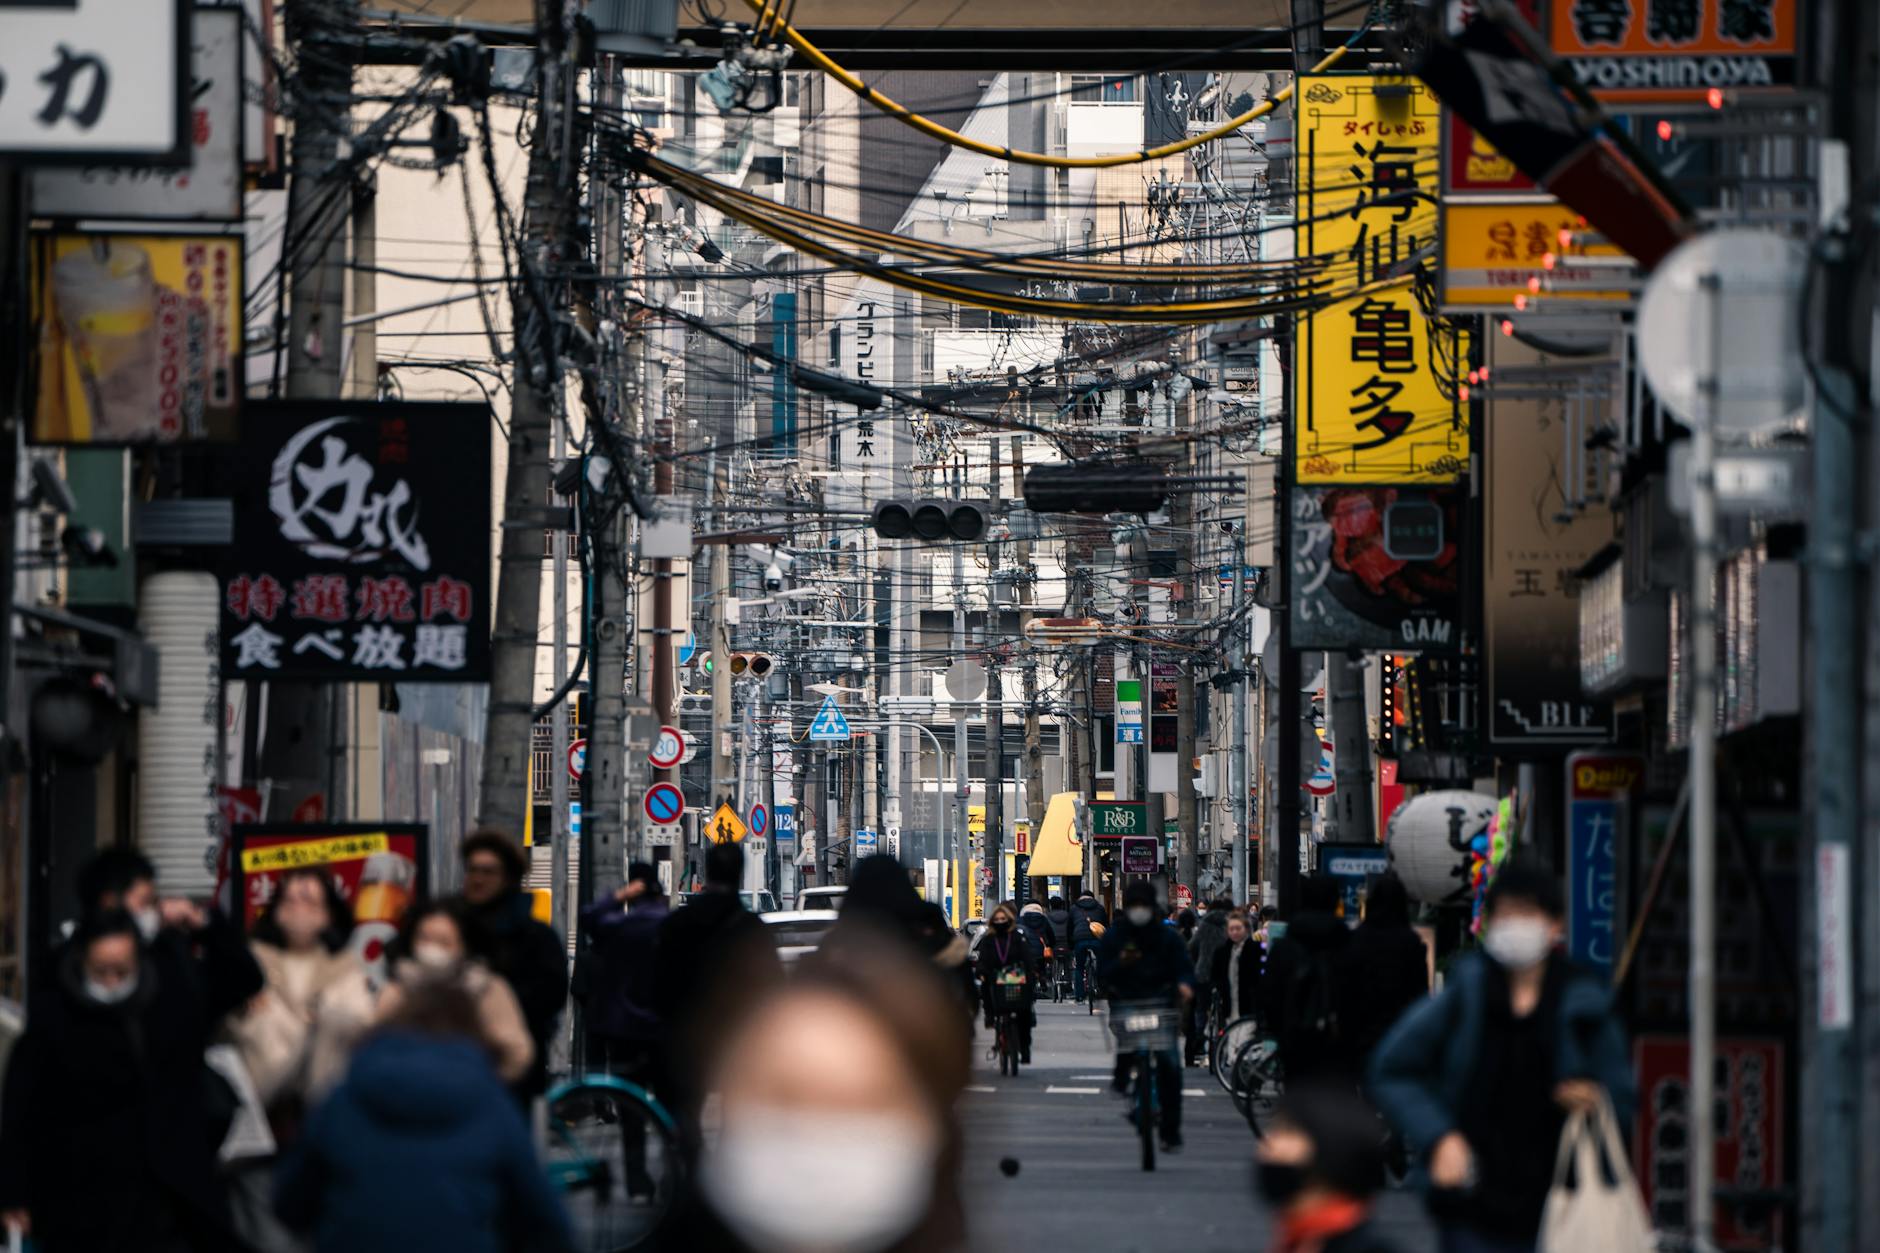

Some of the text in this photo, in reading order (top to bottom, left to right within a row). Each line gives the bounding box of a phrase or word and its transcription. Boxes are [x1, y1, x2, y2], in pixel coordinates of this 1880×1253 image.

[857, 302, 875, 457] グランビ荒木
[227, 574, 471, 622] 特選焼肉
[231, 622, 468, 669] 食べ放題
[654, 739, 677, 757] 30
[1104, 811, 1136, 827] R&B
